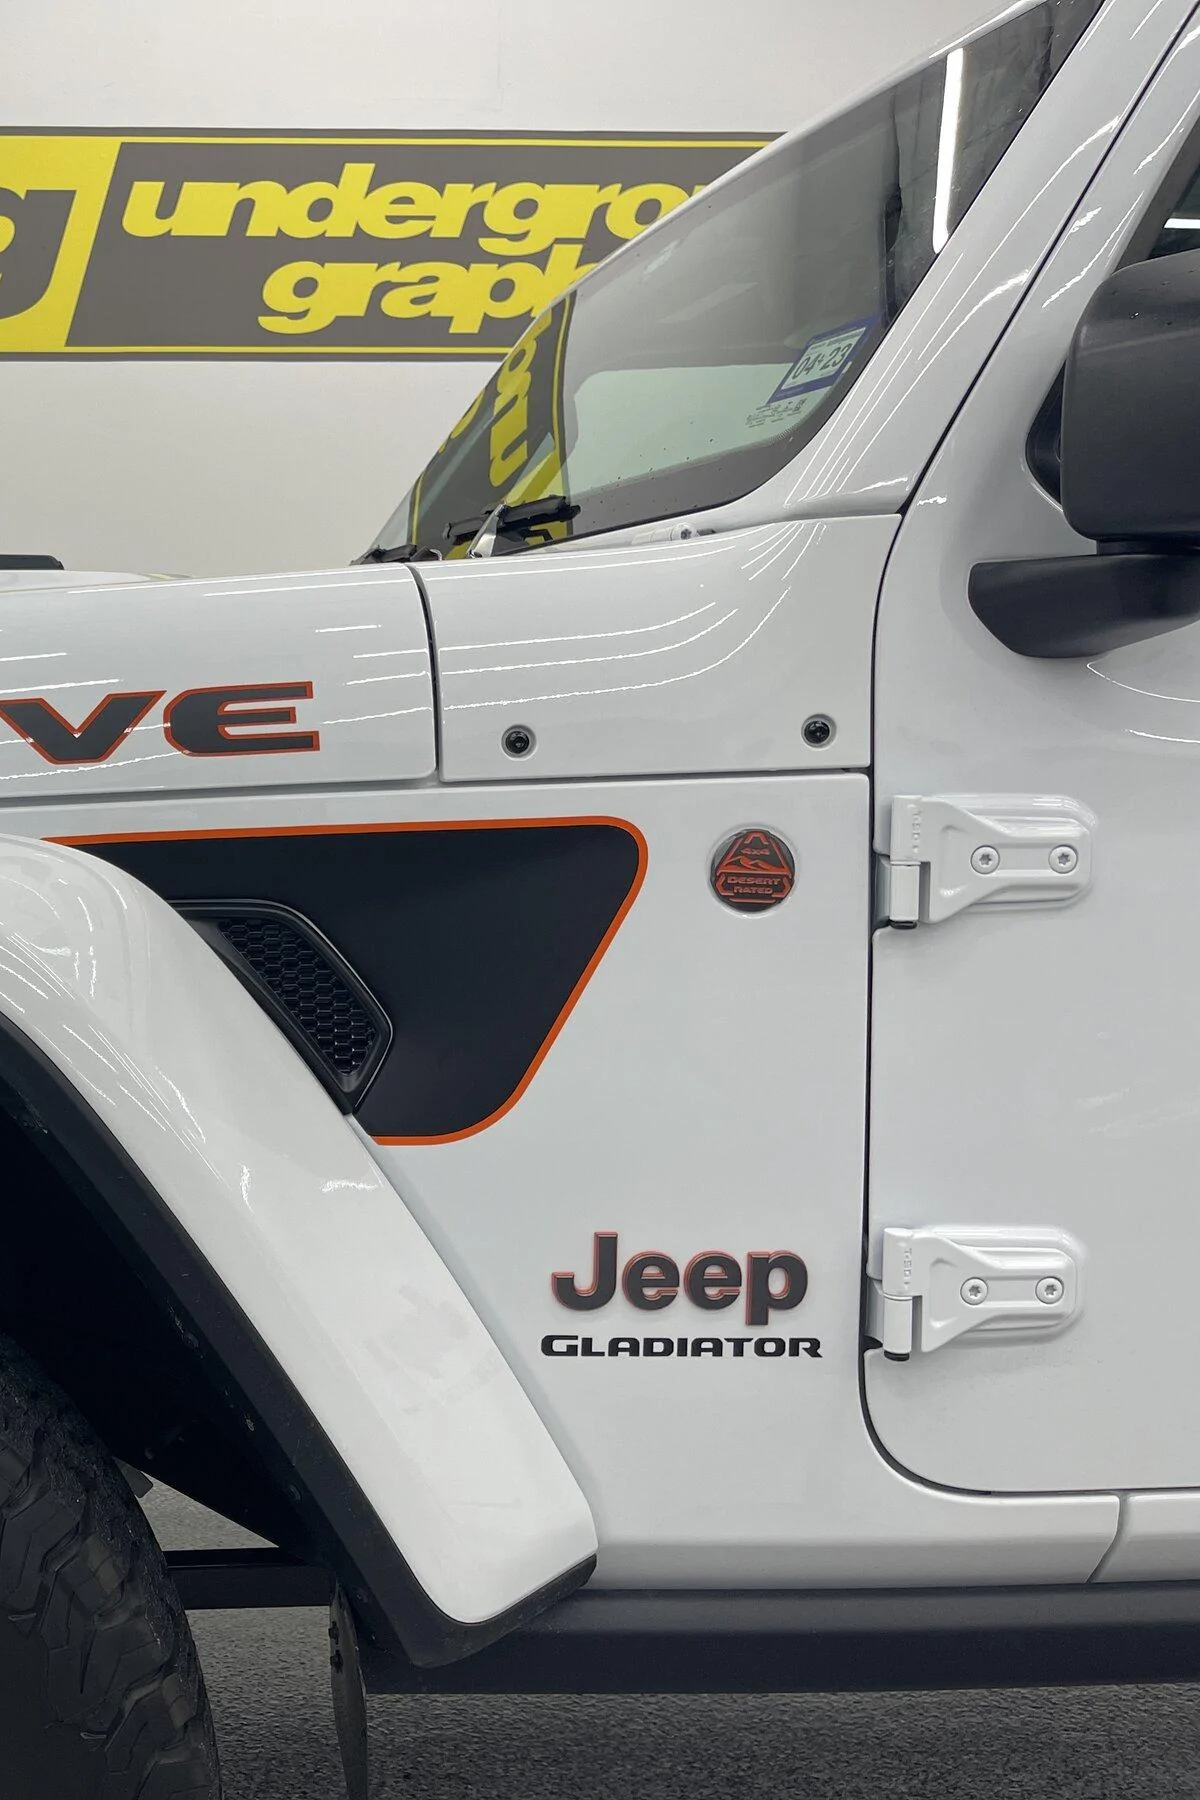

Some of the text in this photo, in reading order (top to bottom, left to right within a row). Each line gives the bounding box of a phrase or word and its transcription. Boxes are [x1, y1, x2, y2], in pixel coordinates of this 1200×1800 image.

[122, 162, 706, 256] undergro
[726, 876, 781, 885] DESERT
[733, 886, 773, 894] RATED
[551, 1231, 809, 1326] Jeep
[540, 1334, 823, 1358] GLADIATOR
